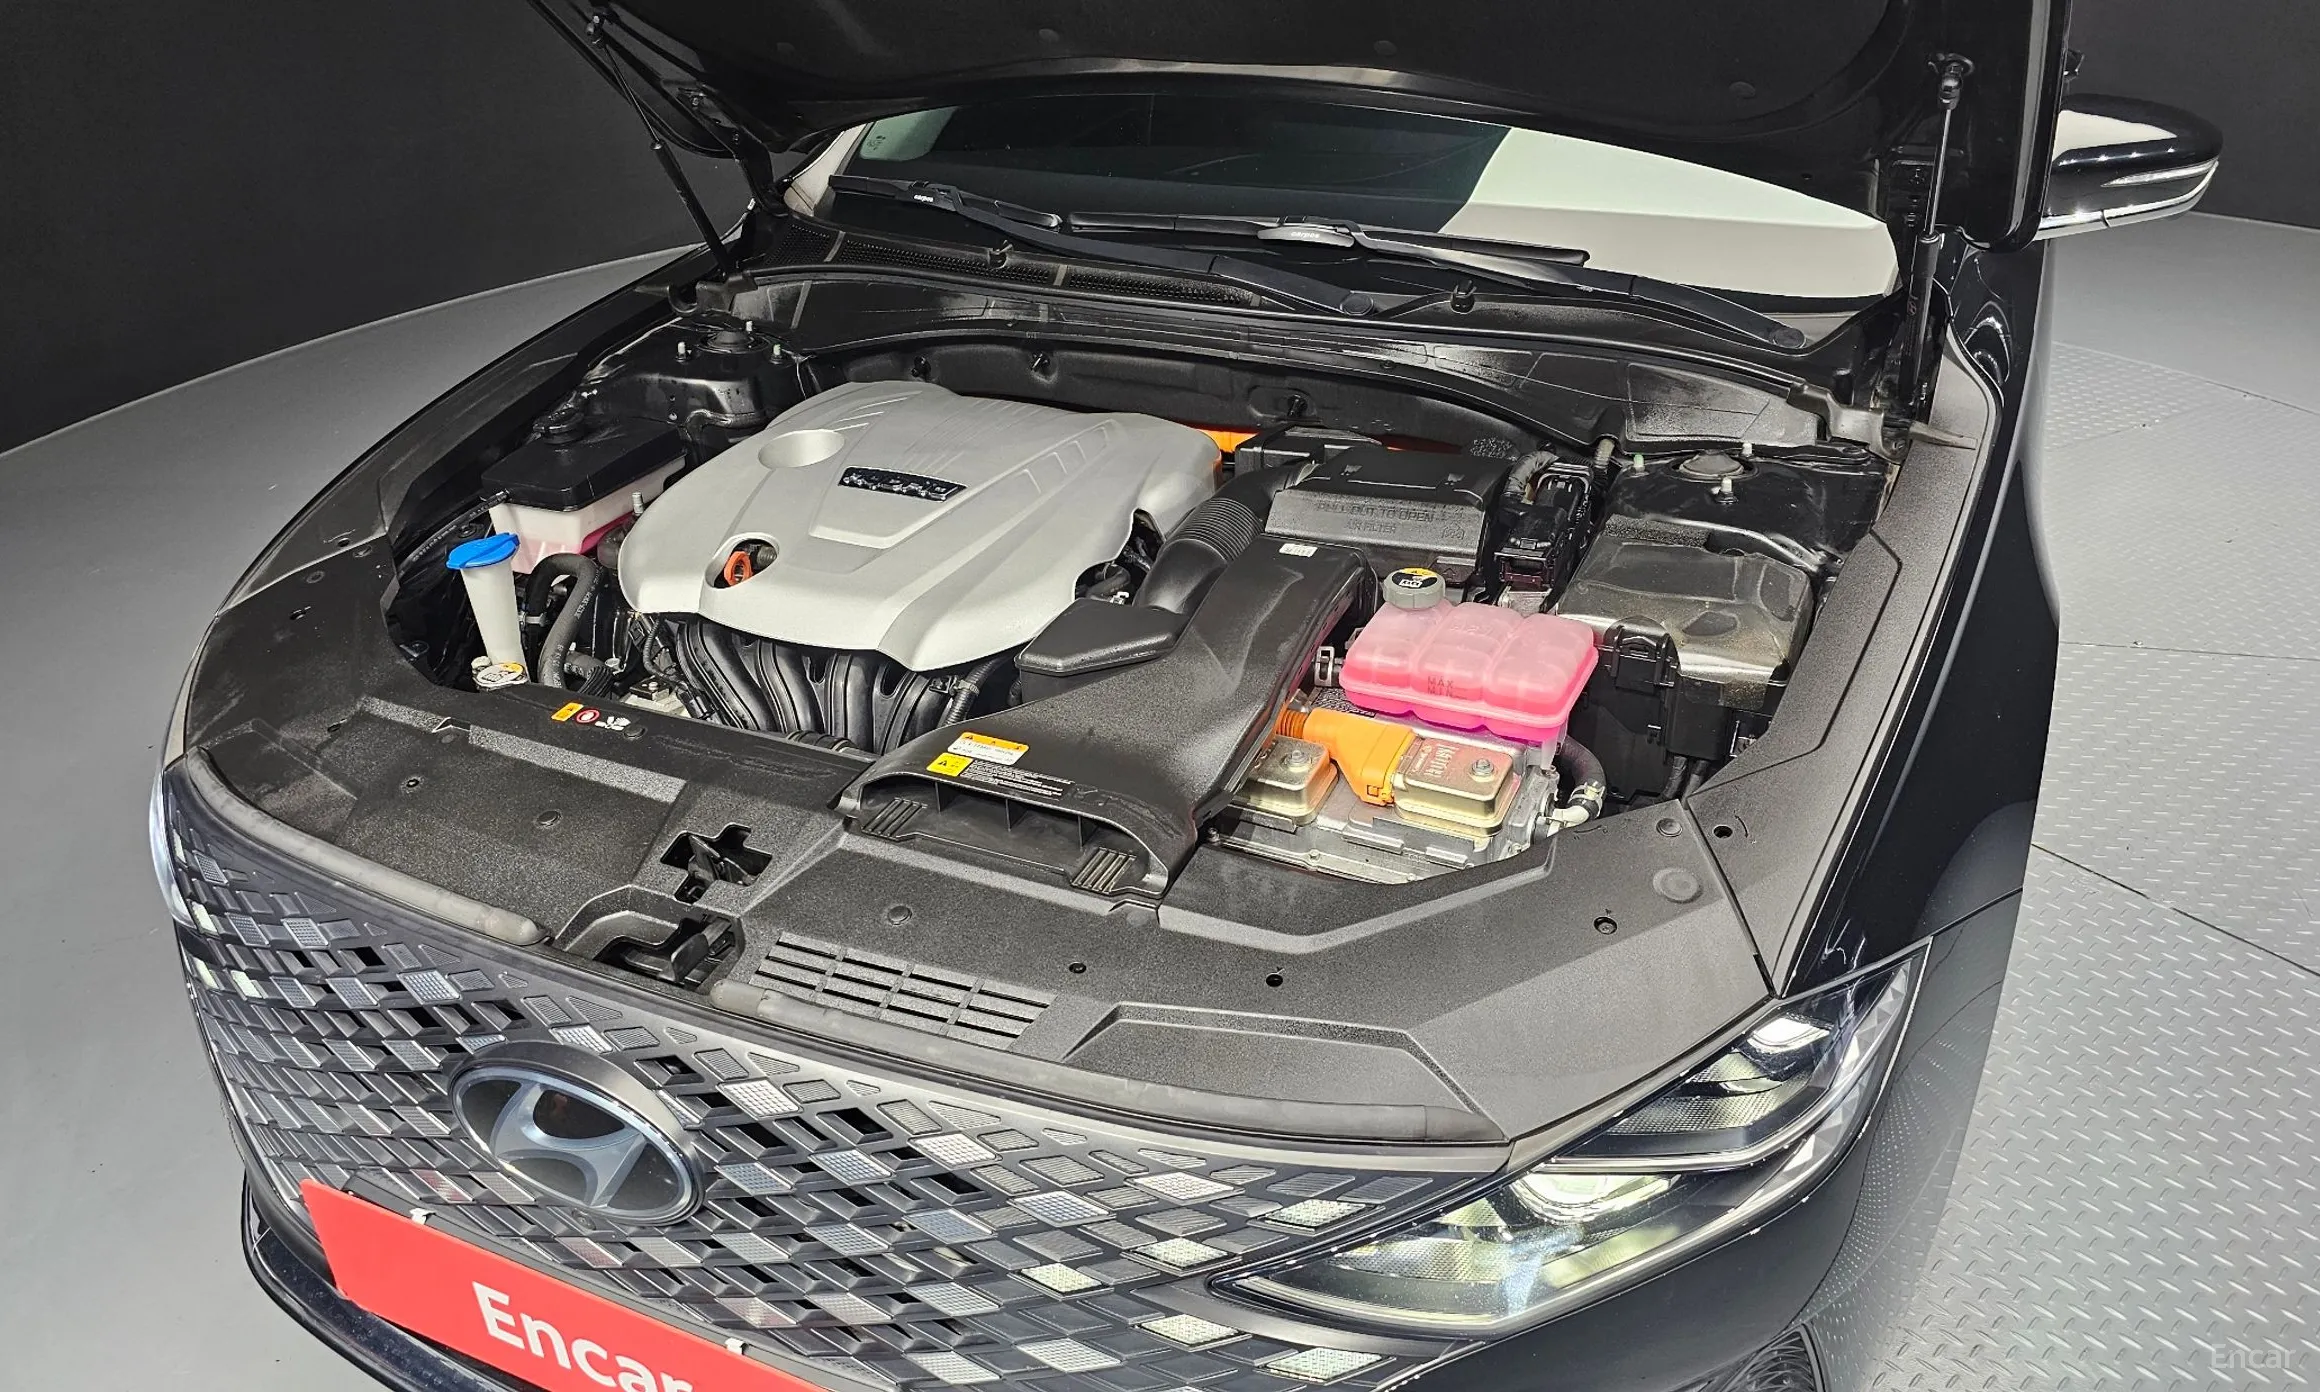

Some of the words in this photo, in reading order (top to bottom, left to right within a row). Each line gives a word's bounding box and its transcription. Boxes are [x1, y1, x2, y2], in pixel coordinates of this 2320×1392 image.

[1351, 504, 1375, 518] OUT
[1379, 506, 1396, 519] TO
[1400, 508, 1435, 522] OPEN
[1363, 521, 1397, 534] FILTER
[1427, 675, 1454, 689] MAX
[1427, 686, 1454, 698] MIN
